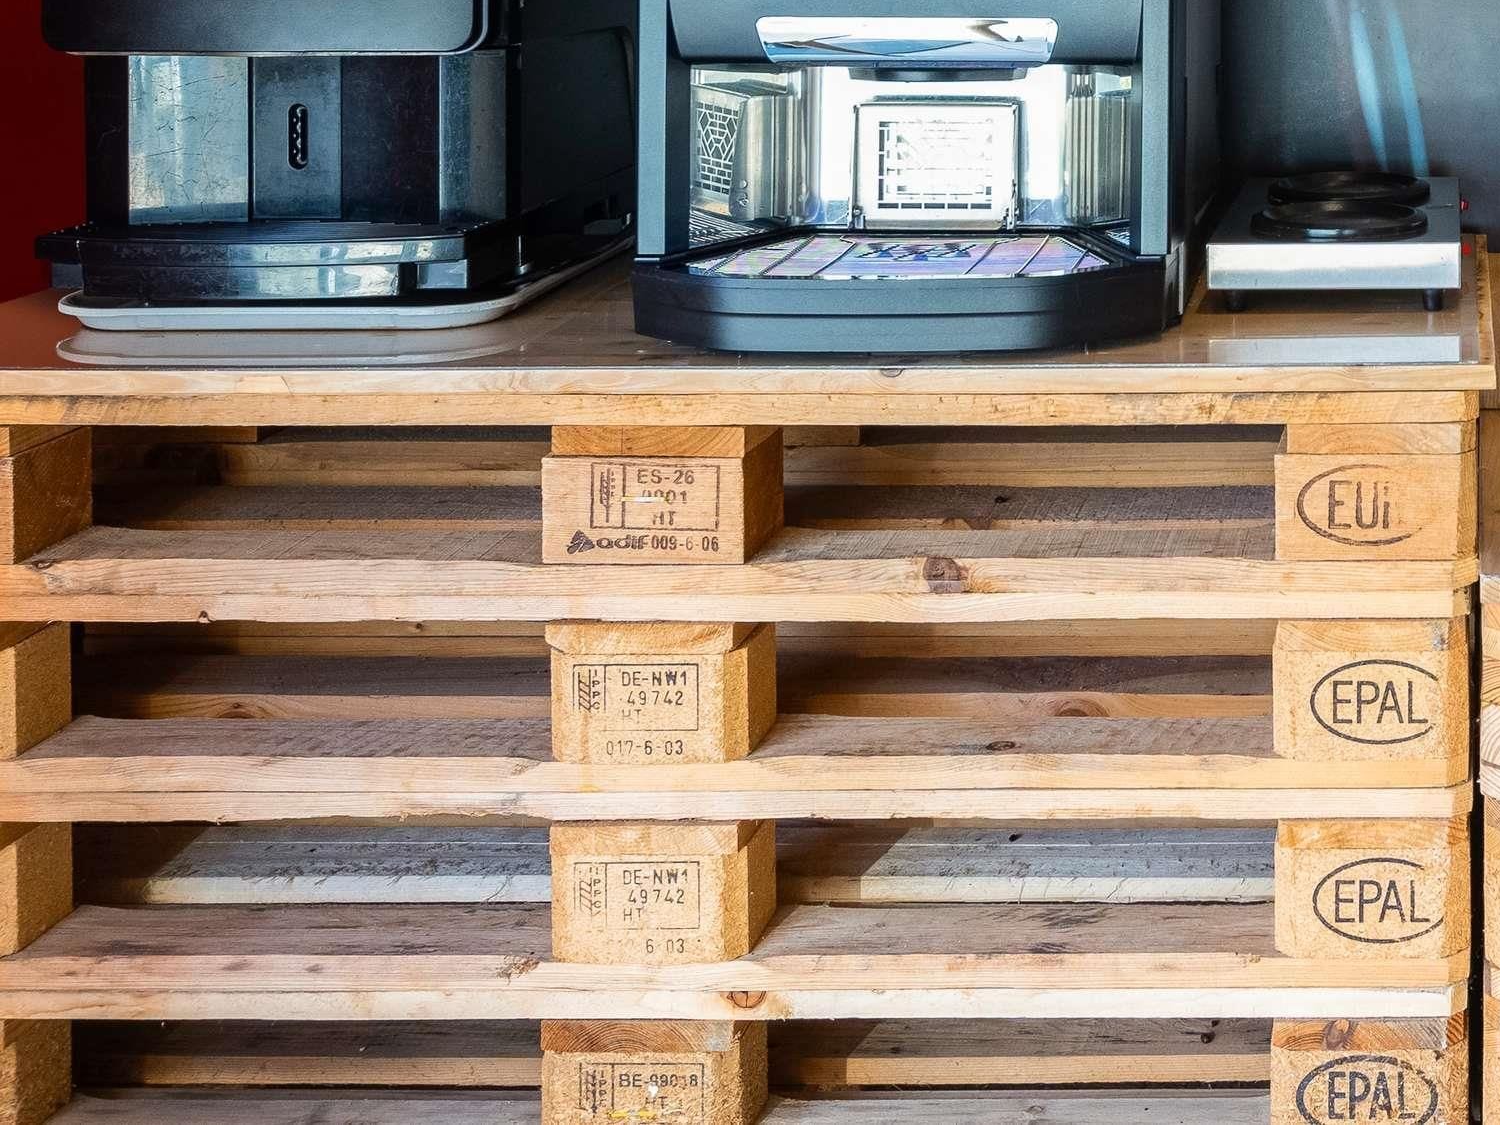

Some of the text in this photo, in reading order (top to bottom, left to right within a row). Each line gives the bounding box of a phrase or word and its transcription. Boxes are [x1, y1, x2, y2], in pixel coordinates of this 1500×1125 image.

[636, 468, 696, 485] ES-26
[621, 670, 688, 687] DE-NW1
[626, 690, 684, 706] 49742
[1331, 680, 1428, 725] EPAL
[606, 740, 684, 757] 017-6-03
[622, 868, 689, 886] DE-NW1
[628, 889, 686, 904] 49742
[1334, 880, 1430, 924] EPAL
[622, 907, 644, 922] HT
[1325, 1070, 1417, 1121] EPAL
